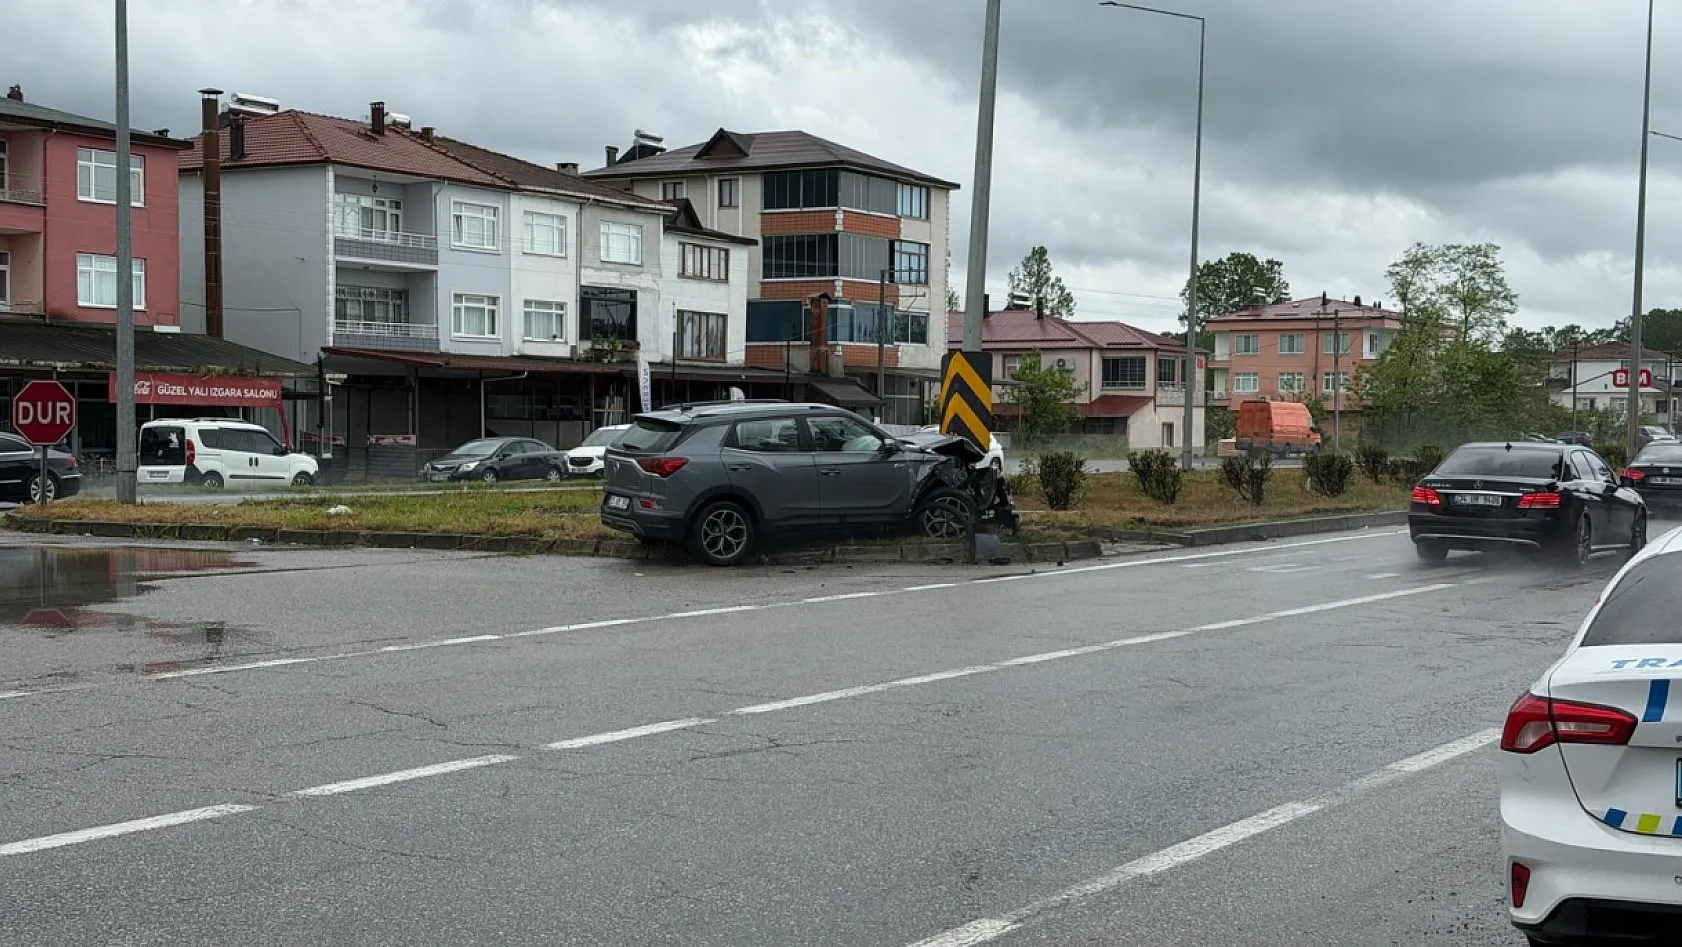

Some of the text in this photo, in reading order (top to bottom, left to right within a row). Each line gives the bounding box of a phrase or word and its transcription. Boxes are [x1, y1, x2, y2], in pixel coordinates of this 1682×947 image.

[157, 383, 278, 399] GÜZEL YALI IZGARA SALONU
[17, 401, 71, 425] DUR
